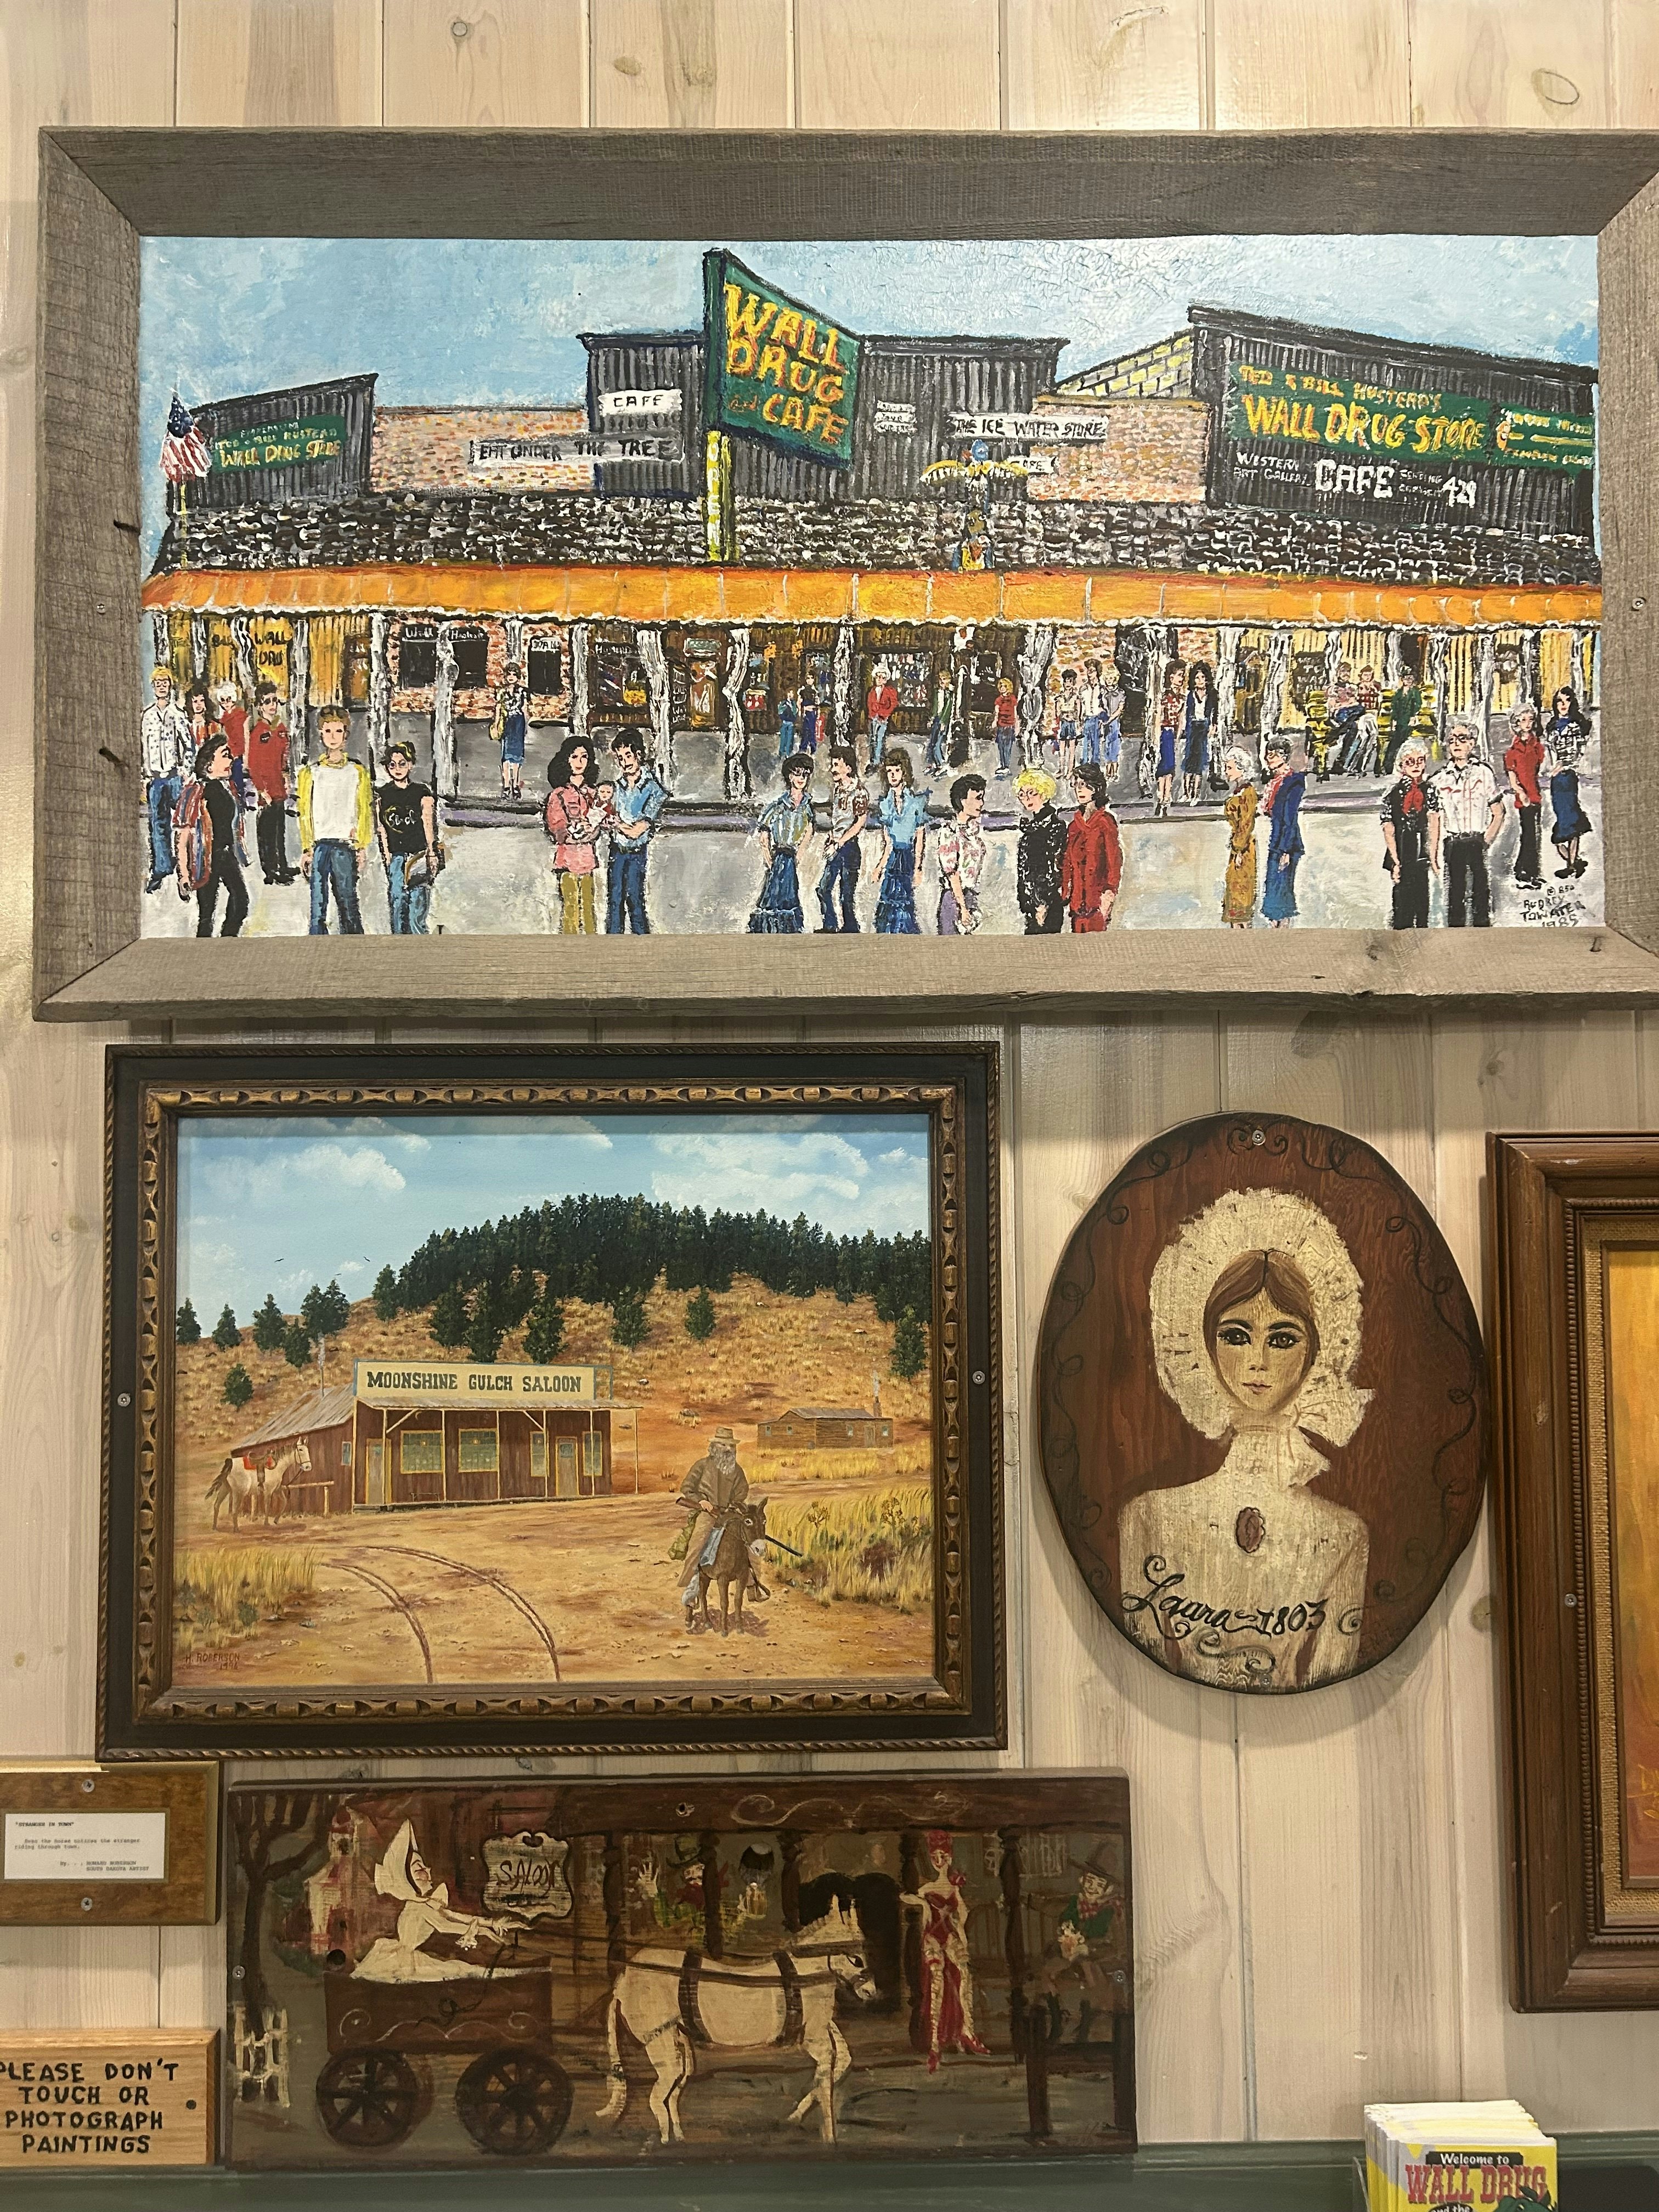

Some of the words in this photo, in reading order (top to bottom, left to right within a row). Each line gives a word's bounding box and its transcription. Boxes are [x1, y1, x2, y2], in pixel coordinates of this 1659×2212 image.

[723, 283, 851, 374] WALL
[726, 335, 844, 404] DRUG
[1239, 365, 1273, 385] TED
[1301, 376, 1344, 398] BILL
[613, 394, 664, 408] CAFE
[763, 393, 849, 445] CAFE
[956, 419, 977, 434] THE
[982, 418, 1005, 435] ICE
[1014, 421, 1059, 438] WATER
[1062, 421, 1106, 437] STORE
[1241, 394, 1320, 442] WALL
[1324, 401, 1407, 450] DRUG
[1408, 414, 1486, 453] STORE
[510, 444, 562, 461] UNDER
[575, 441, 611, 456] THE
[618, 439, 678, 460] TREE
[1237, 452, 1300, 471] WESTERN
[1233, 467, 1259, 481] ART
[1315, 459, 1395, 498] CAFE
[1441, 476, 1477, 509] 429
[254, 631, 292, 646] WALL
[1542, 913, 1579, 927] 1985
[367, 1372, 458, 1390] MOONSHINE
[469, 1374, 512, 1391] GULCH
[522, 1375, 582, 1392] SALOON
[1122, 1554, 1232, 1640] Laura
[1257, 1599, 1328, 1639] 1803
[105, 2058, 179, 2081] DON'T
[18, 2086, 100, 2104] TOUCH
[119, 2086, 149, 2105] OR
[5, 2111, 162, 2131] PHOTOGRAPH
[22, 2134, 150, 2153] PAINTINGS
[1440, 2153, 1493, 2164] Welcome
[1497, 2154, 1509, 2164] to
[1405, 2164, 1474, 2204] WALL
[1480, 2165, 1547, 2204] DRUG
